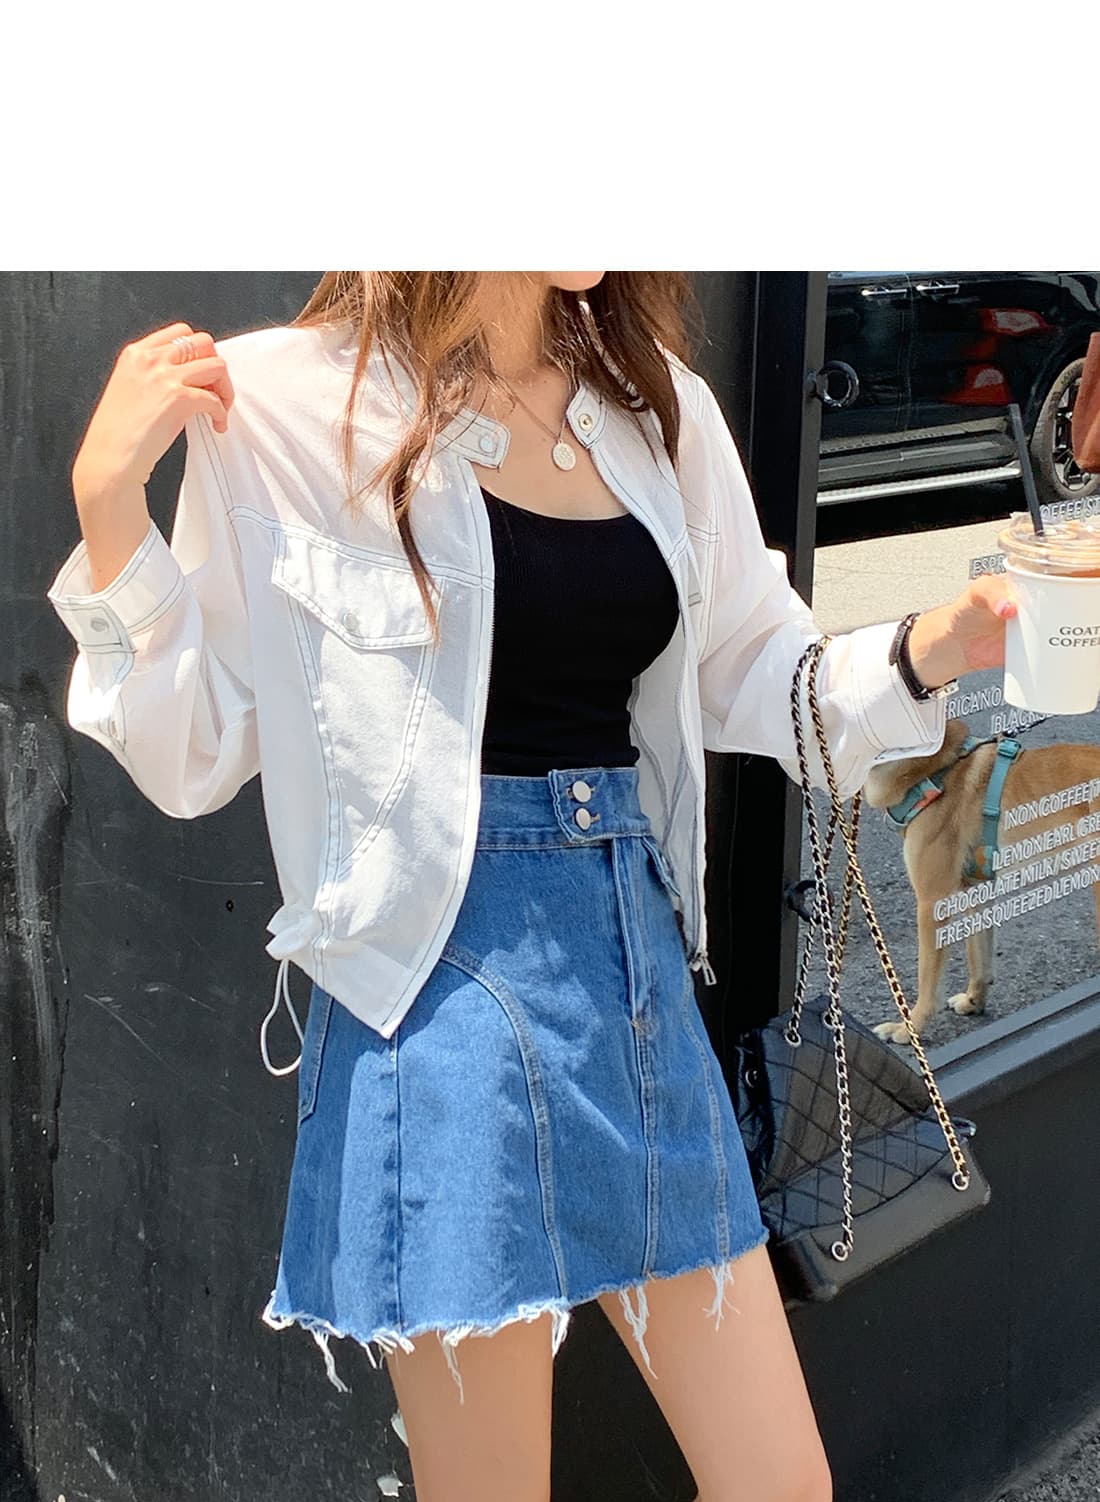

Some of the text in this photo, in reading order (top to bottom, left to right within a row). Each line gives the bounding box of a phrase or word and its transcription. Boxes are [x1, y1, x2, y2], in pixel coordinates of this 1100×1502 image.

[1059, 626, 1100, 635] GOAT
[992, 834, 1044, 872] LEMON
[1044, 823, 1076, 850] EARL
[934, 871, 1021, 921] CHOCOLATE
[1060, 838, 1100, 870] SWEE
[936, 912, 982, 949] FRESH
[981, 884, 1053, 927] SQUEEZED
